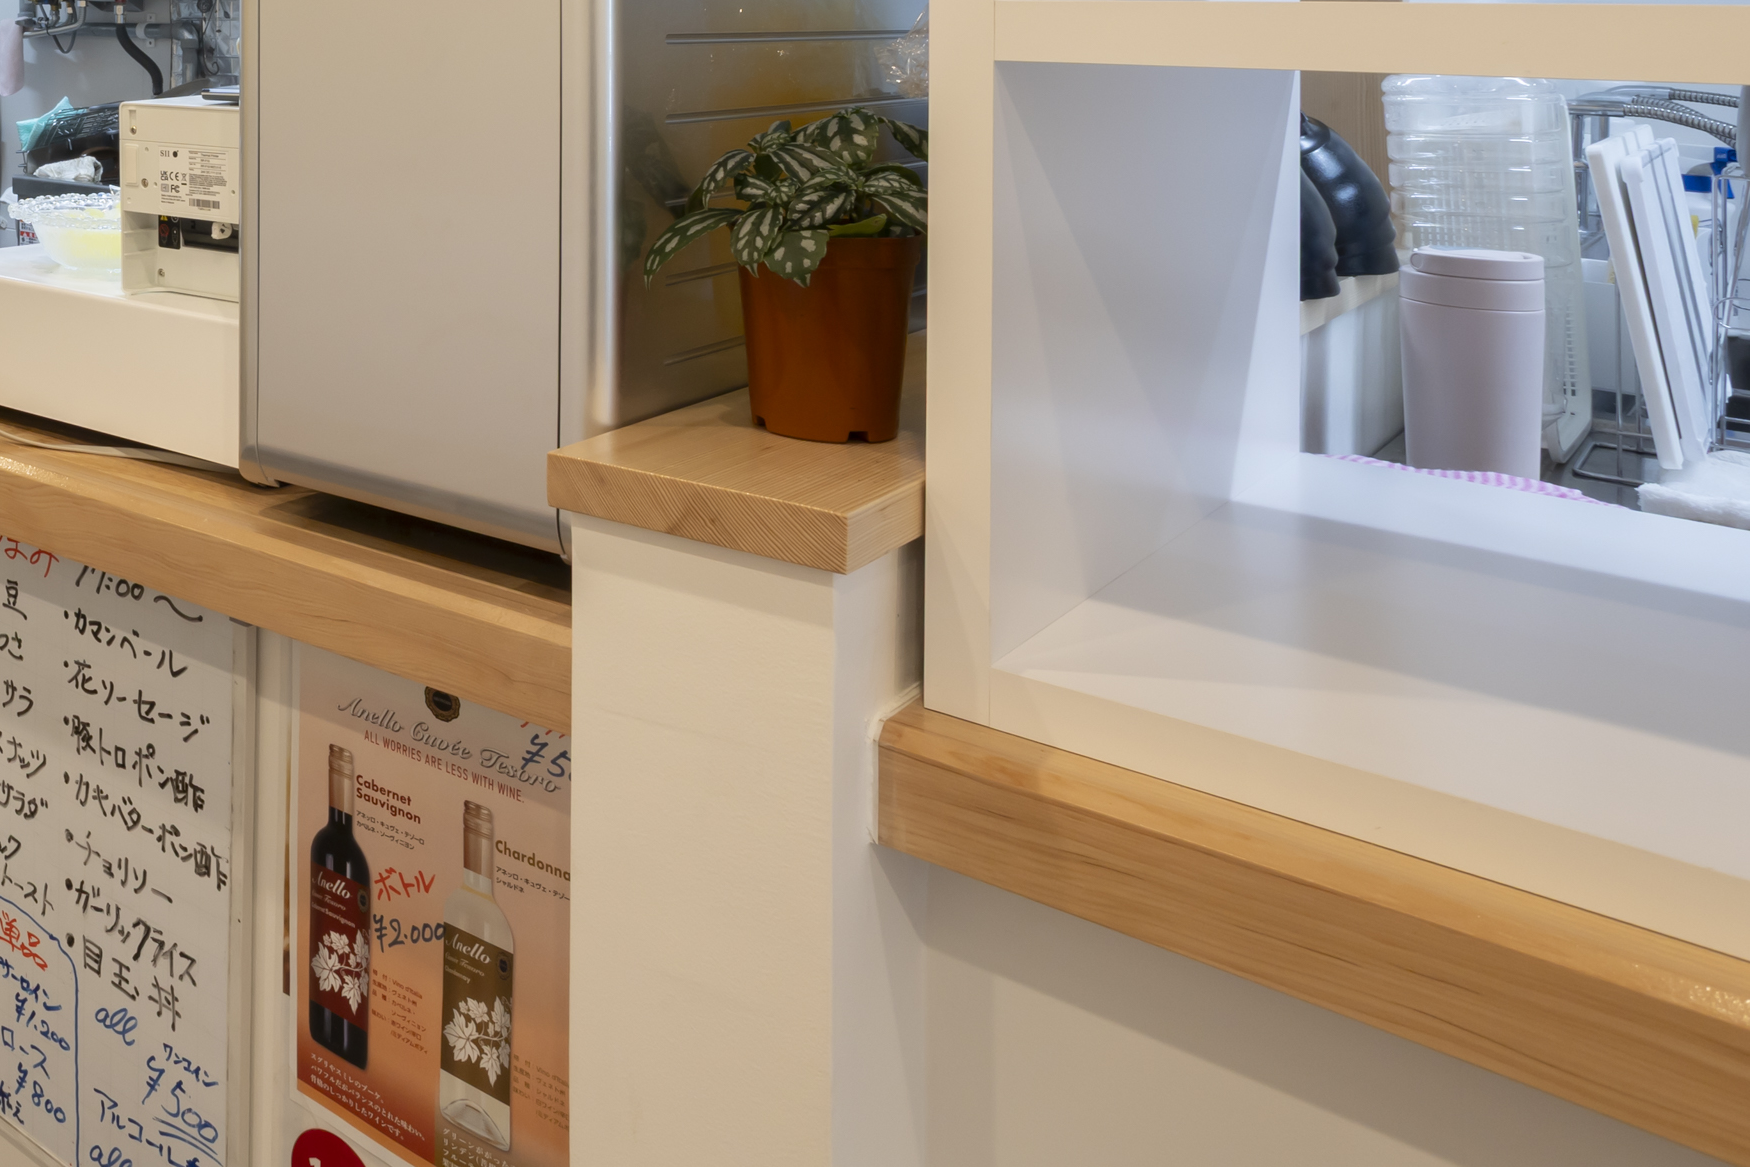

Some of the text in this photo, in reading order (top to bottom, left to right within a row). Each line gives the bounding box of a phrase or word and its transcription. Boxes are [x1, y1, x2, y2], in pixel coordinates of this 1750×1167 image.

[73, 607, 189, 678] カマンベール
[337, 696, 405, 733] Anello
[410, 720, 473, 762] Cuvée
[479, 746, 562, 795] Tesoro
[520, 732, 572, 783] ¥5
[363, 729, 526, 804] ALL WORRIES ARE LESS WITH WINE.
[355, 774, 412, 807] Cabernet
[355, 786, 421, 825] Sauvignon
[495, 838, 571, 882] Chardonna
[0, 862, 55, 918] トースト
[312, 870, 352, 899] Anello
[374, 866, 437, 901] ボトル
[495, 865, 571, 902] アネッロ・キュヴェ・テゾー
[372, 913, 447, 953] ¥2.000
[444, 933, 492, 965] Anello
[81, 933, 183, 1033] 目玉丼
[93, 1006, 139, 1047] all
